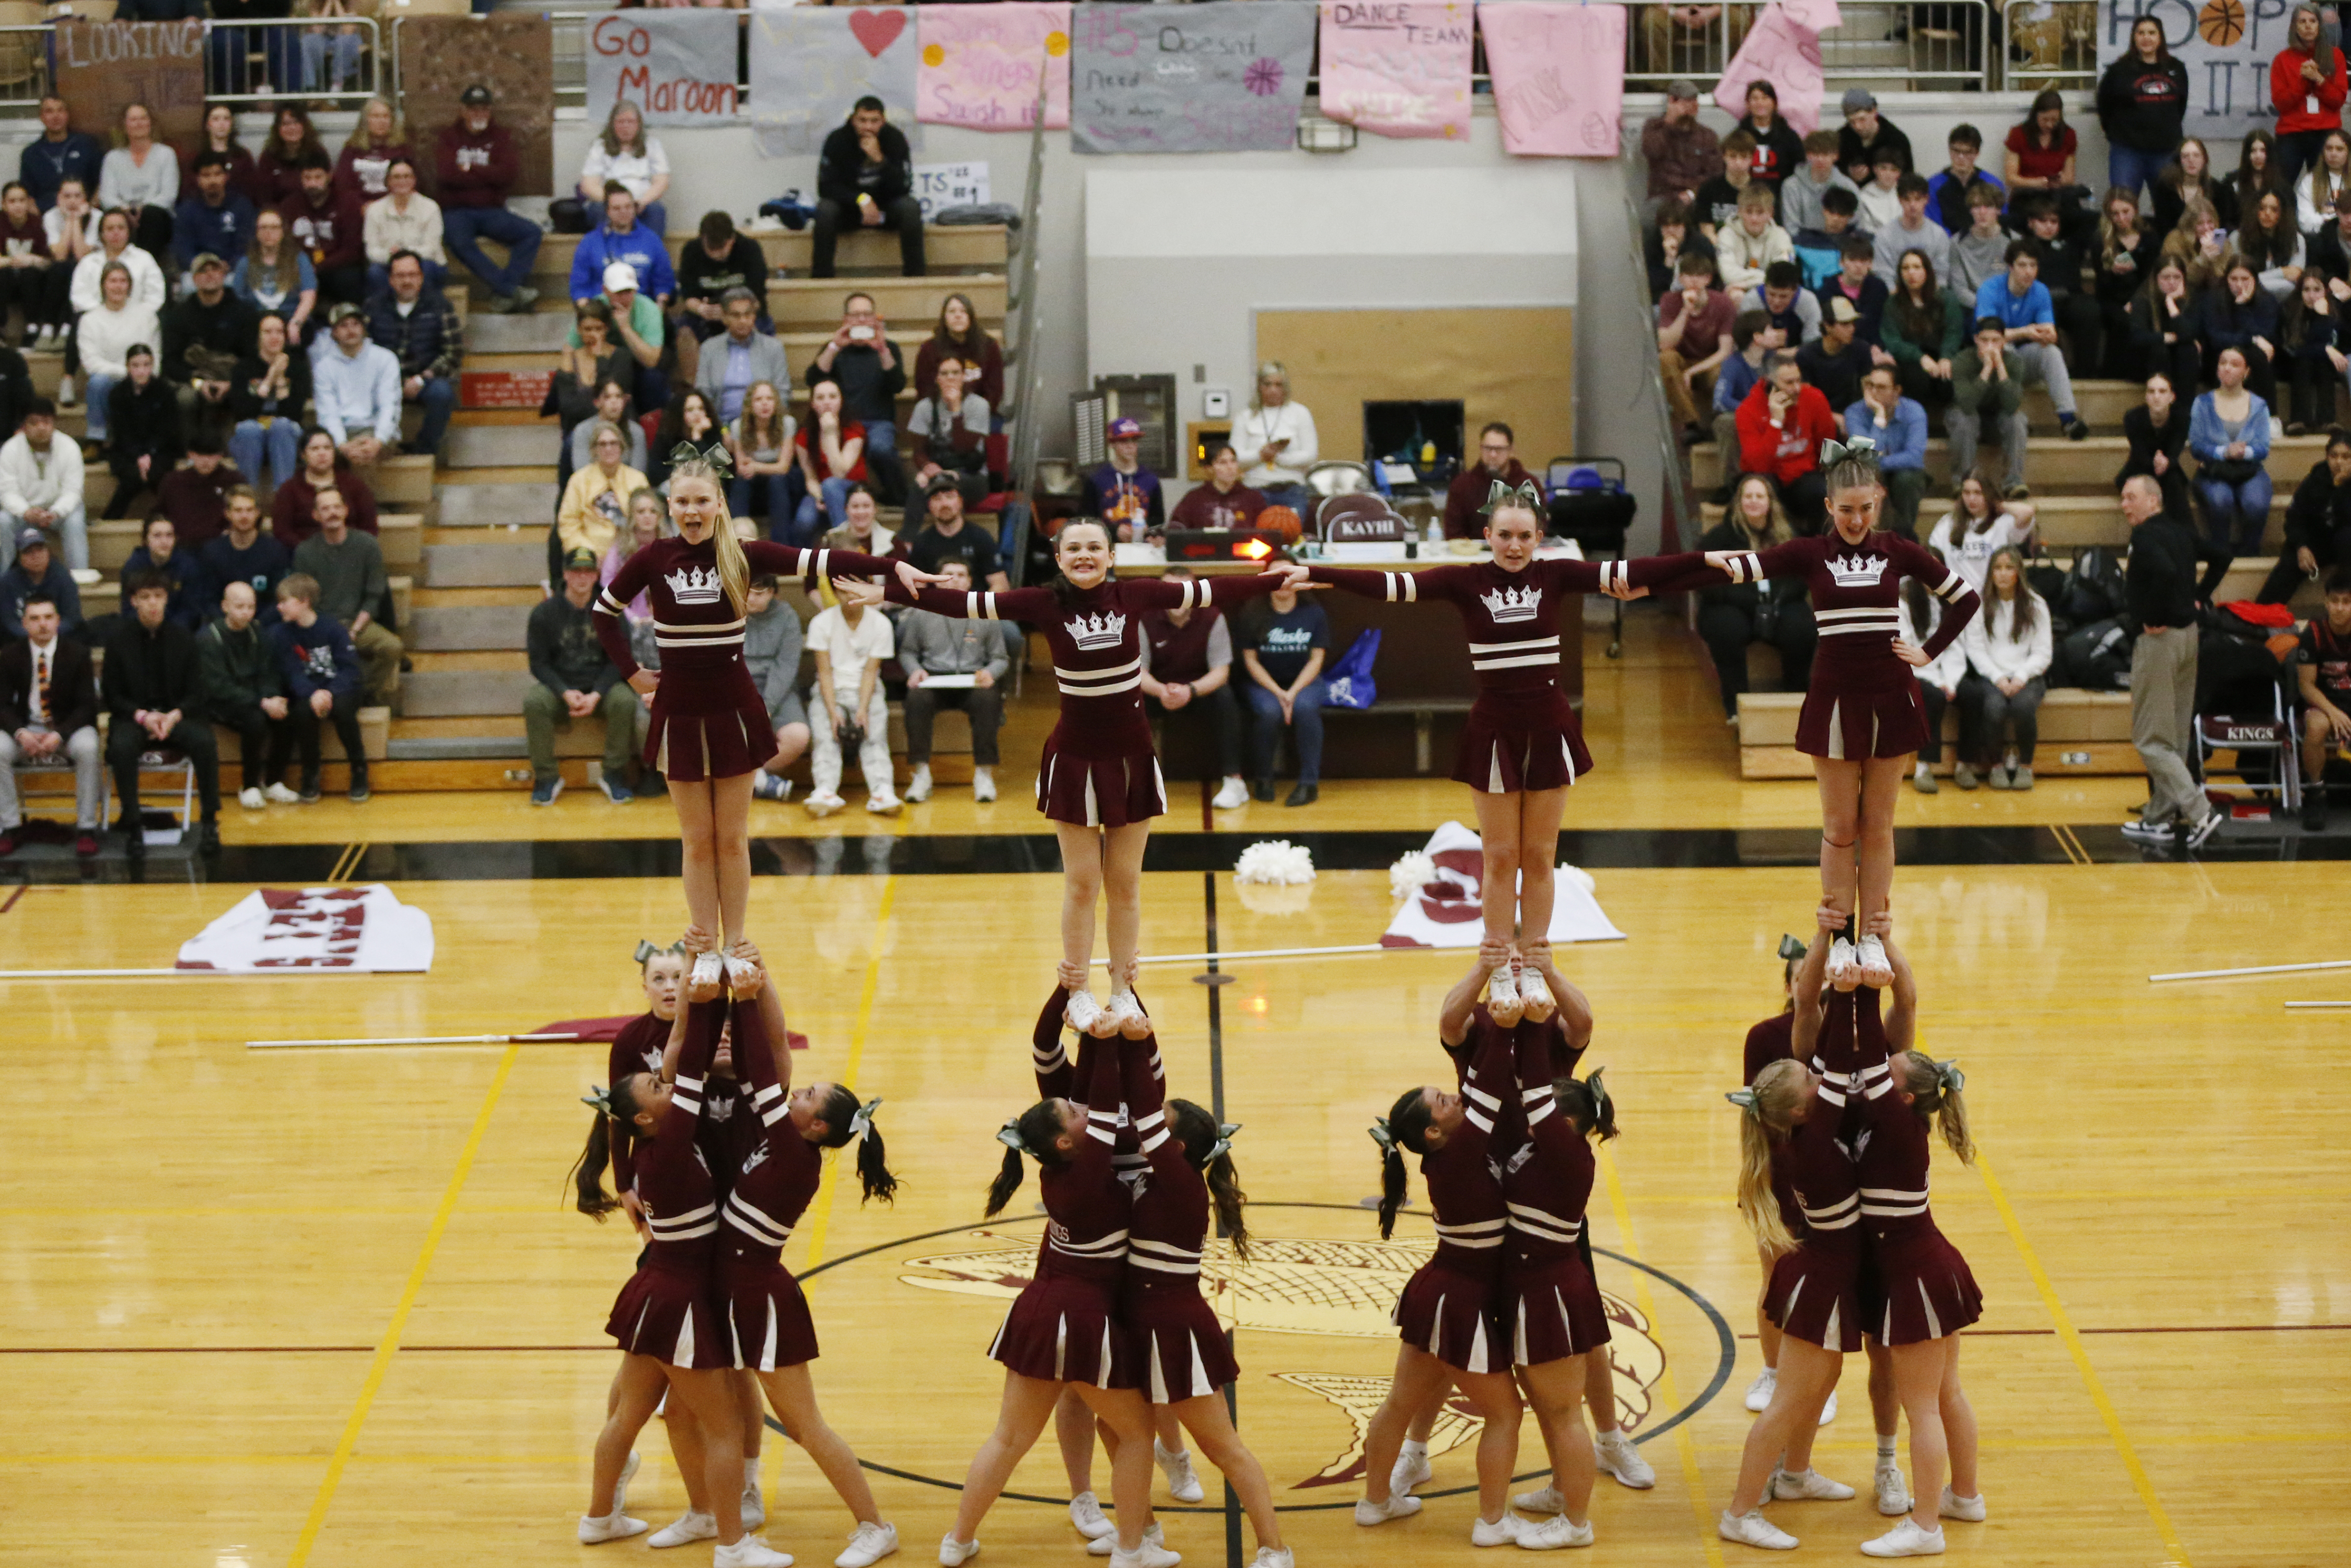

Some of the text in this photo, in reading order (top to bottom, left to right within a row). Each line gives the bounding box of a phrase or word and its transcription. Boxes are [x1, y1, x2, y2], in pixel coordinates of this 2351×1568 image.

[1335, 3, 1410, 24] DANCE
[65, 22, 202, 67] LOOKING
[1402, 24, 1470, 44] TEAM
[617, 65, 738, 114] Maroon
[2203, 61, 2240, 117] IT
[1342, 520, 1395, 535] KAYHI
[2227, 727, 2274, 741] KINGS
